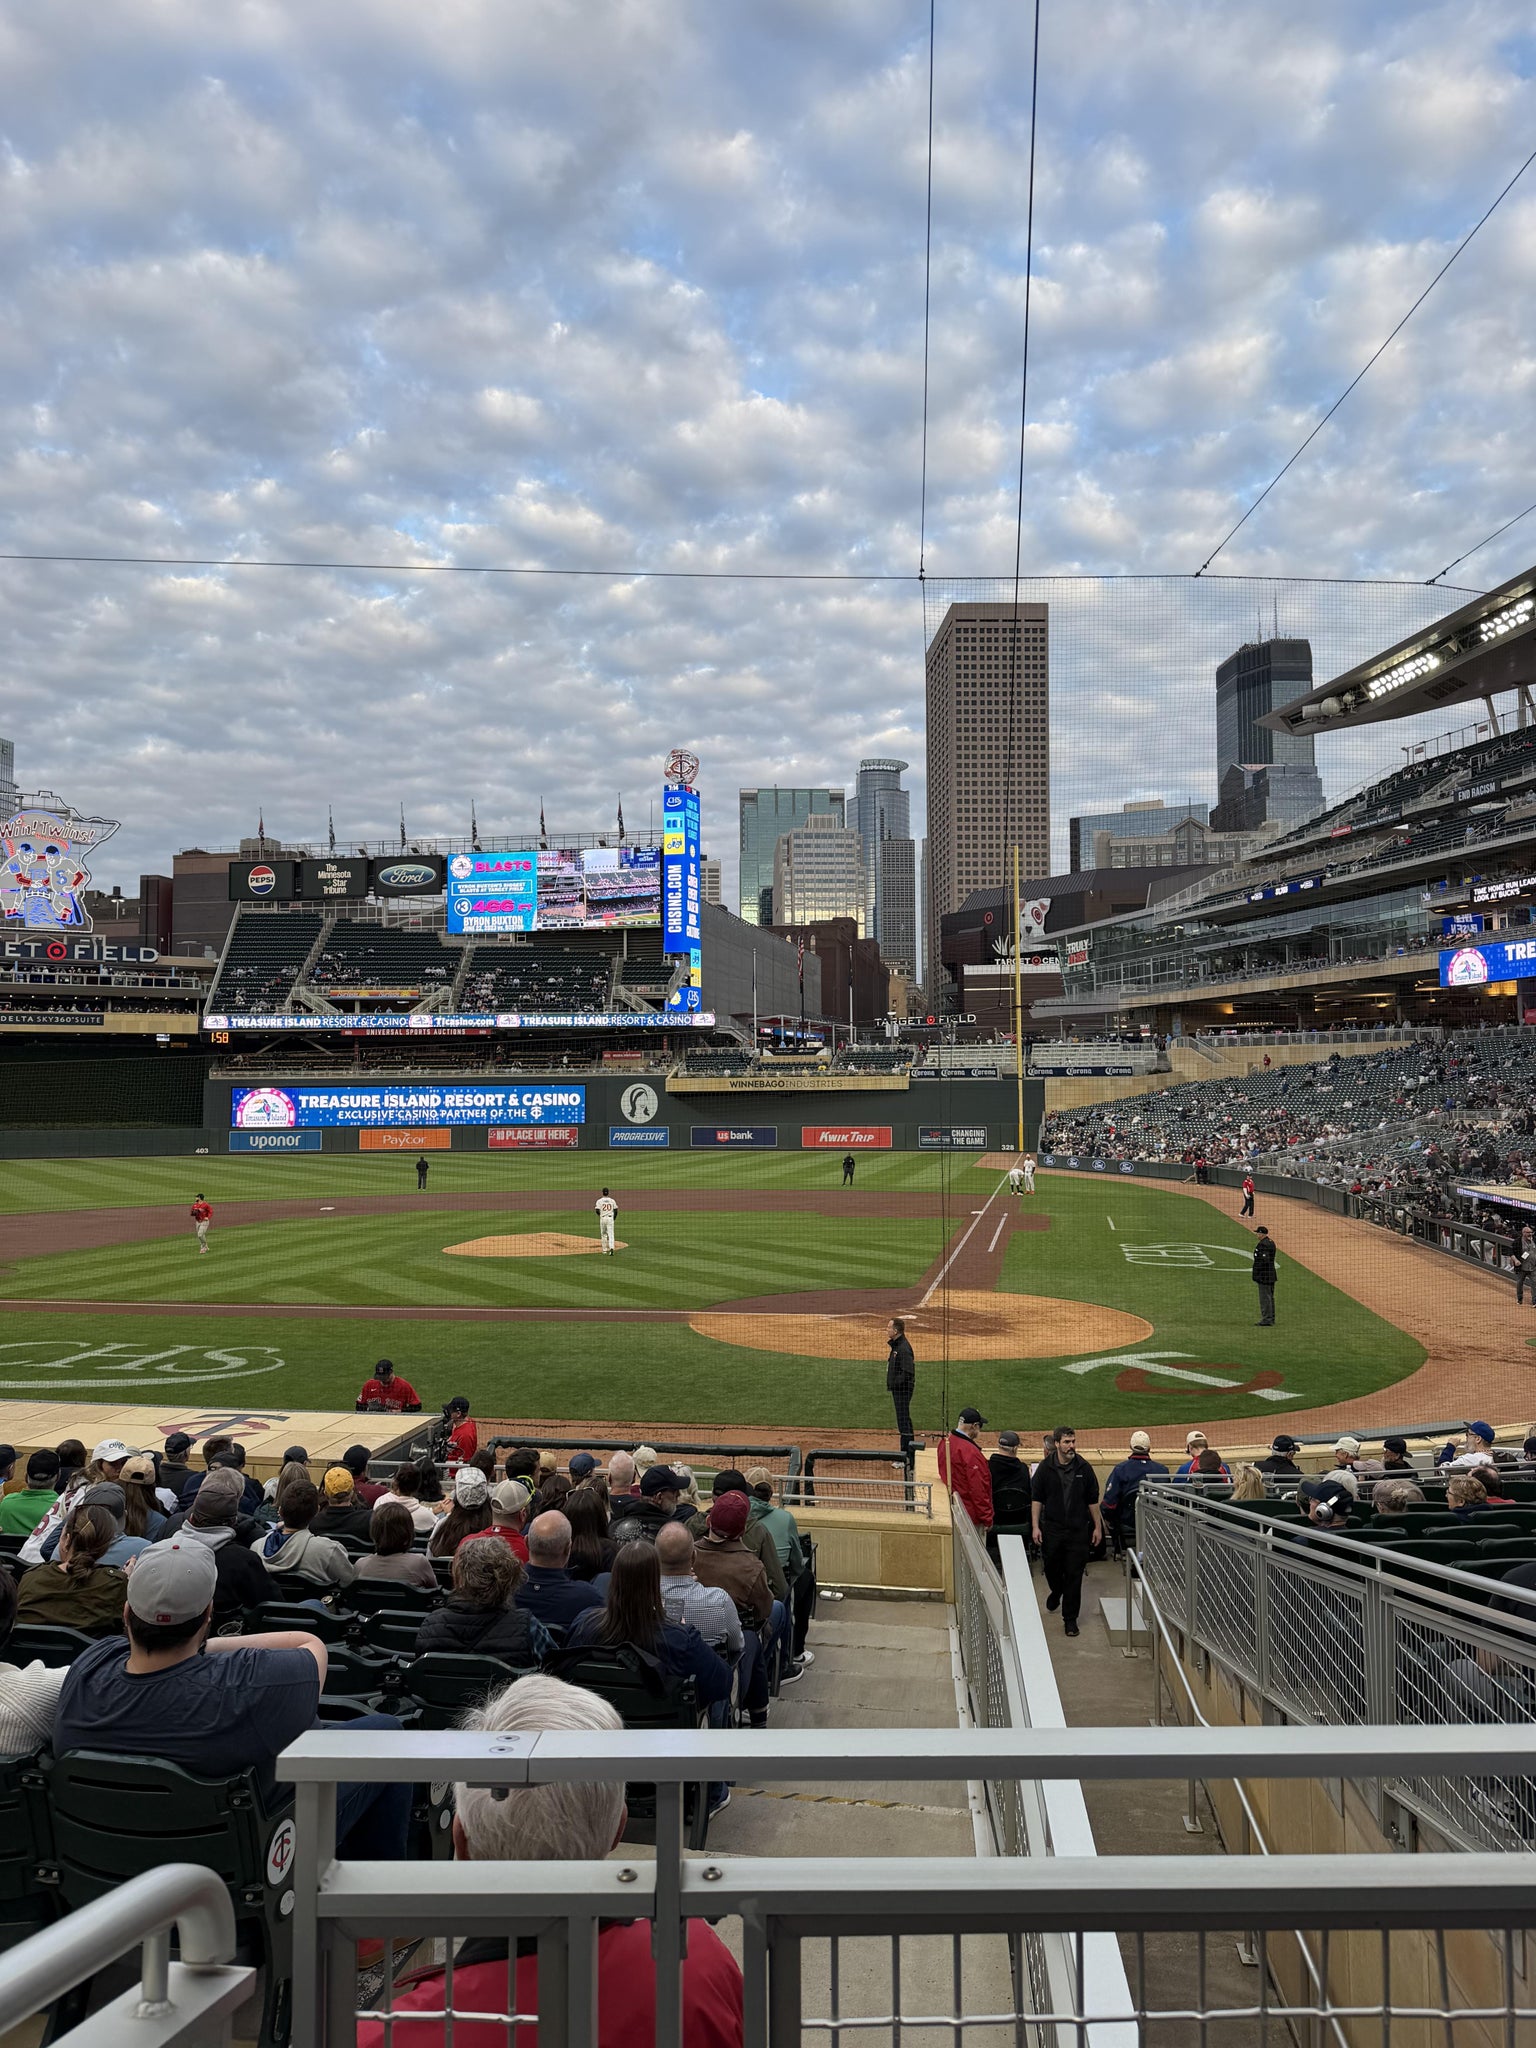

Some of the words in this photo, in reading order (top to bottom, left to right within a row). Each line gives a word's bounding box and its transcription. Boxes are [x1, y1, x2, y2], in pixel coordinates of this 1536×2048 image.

[0, 820, 38, 839] Win!
[41, 820, 96, 843] Twins!
[325, 863, 338, 871] The
[475, 861, 532, 873] BLASTS
[250, 876, 274, 884] PEPSI
[317, 870, 351, 880] Minnesota
[389, 867, 425, 884] Ford
[332, 878, 348, 887] Star
[323, 886, 347, 895] Tribune
[1488, 885, 1505, 894] HOME
[1506, 882, 1519, 890] RUN
[667, 864, 682, 933] CHSINC.COM
[1474, 894, 1490, 902] LOOK
[1490, 892, 1498, 900] AT
[1498, 887, 1520, 898] BUCK'S
[472, 899, 515, 913] 466
[463, 916, 490, 926] BYRON
[491, 915, 523, 926] BUXTON
[74, 944, 159, 963] FIELD
[1505, 941, 1536, 961] TRE
[1, 1015, 34, 1023] DELTA
[231, 1018, 283, 1027] TREASURE
[285, 1018, 321, 1027] ISLAND
[323, 1017, 359, 1026] RESORT
[361, 1018, 369, 1026] &
[370, 1017, 406, 1026] CASINO
[523, 1016, 572, 1025] TREASURE
[574, 1016, 608, 1025] ISLAND
[611, 1016, 645, 1025] RESORT
[647, 1016, 655, 1025] &
[656, 1015, 691, 1025] CASINO
[911, 1068, 935, 1077] Corona
[940, 1068, 966, 1077] Corona
[971, 1067, 996, 1077] Corona
[1027, 1067, 1053, 1076] Corona
[1066, 1067, 1092, 1075] Corona
[1105, 1066, 1132, 1075] Corona
[729, 1080, 785, 1088] WINNEBAGO
[785, 1079, 843, 1088] INDUSTRIES
[299, 1095, 380, 1108] TREASURE
[384, 1094, 441, 1108] ISLAND
[445, 1093, 505, 1107] RESORT
[508, 1093, 519, 1106] &
[522, 1093, 581, 1106] CASINO
[338, 1110, 395, 1120] EXCLUSIVE
[398, 1109, 438, 1119] CASINO
[441, 1109, 487, 1118] PARTNER
[490, 1109, 504, 1118] OF
[507, 1109, 527, 1118] THE
[506, 1129, 533, 1140] PLACE
[548, 1129, 570, 1140] HERE
[612, 1132, 667, 1141] PROGRESSIVE
[730, 1130, 753, 1140] bank
[819, 1131, 850, 1142] KWIK
[850, 1131, 875, 1142] TRIP
[951, 1129, 985, 1137] CHANGING
[250, 1135, 302, 1149] uponor
[382, 1134, 428, 1147] Paycor
[952, 1137, 965, 1145] THE
[966, 1137, 984, 1145] GAME
[602, 1203, 612, 1211] 20
